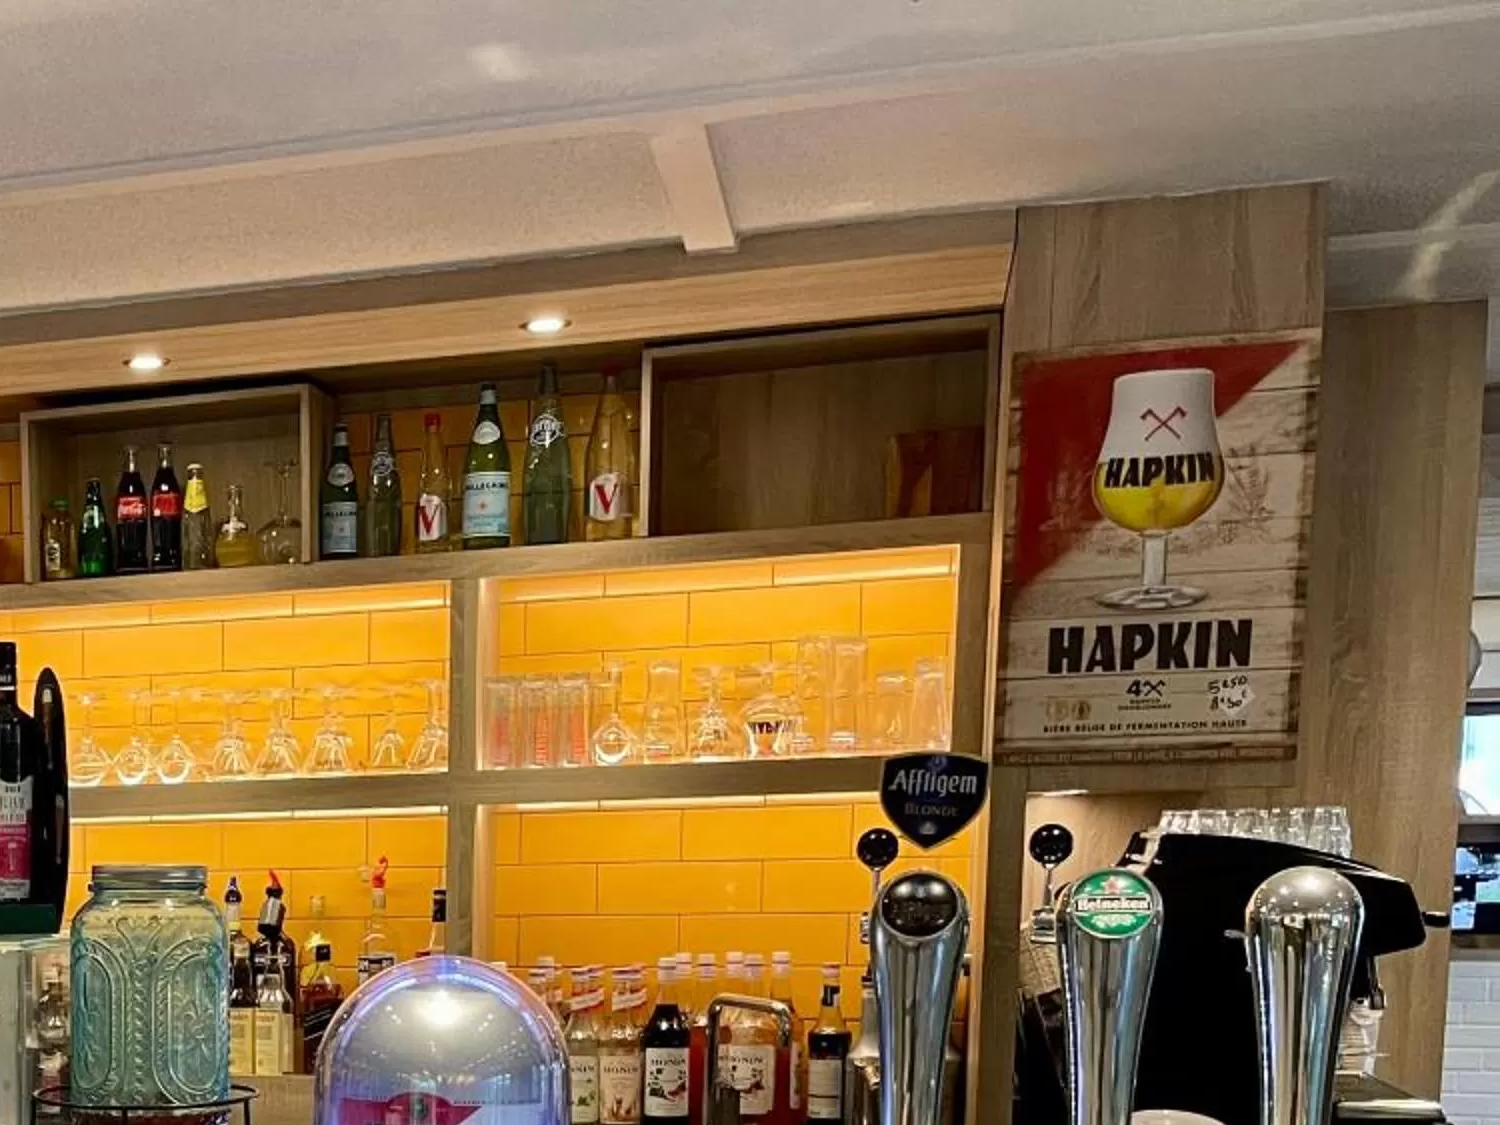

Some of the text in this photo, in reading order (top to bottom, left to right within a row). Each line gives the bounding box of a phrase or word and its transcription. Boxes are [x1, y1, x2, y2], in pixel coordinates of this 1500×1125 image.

[1104, 452, 1215, 488] HAPKIN
[1047, 619, 1252, 674] HAPKIN
[1109, 723, 1122, 731] DE
[1125, 720, 1208, 731] FERMENTATION
[1211, 719, 1248, 728] HAUTE
[887, 768, 978, 798] Affligem
[1076, 897, 1150, 911] Heineken
